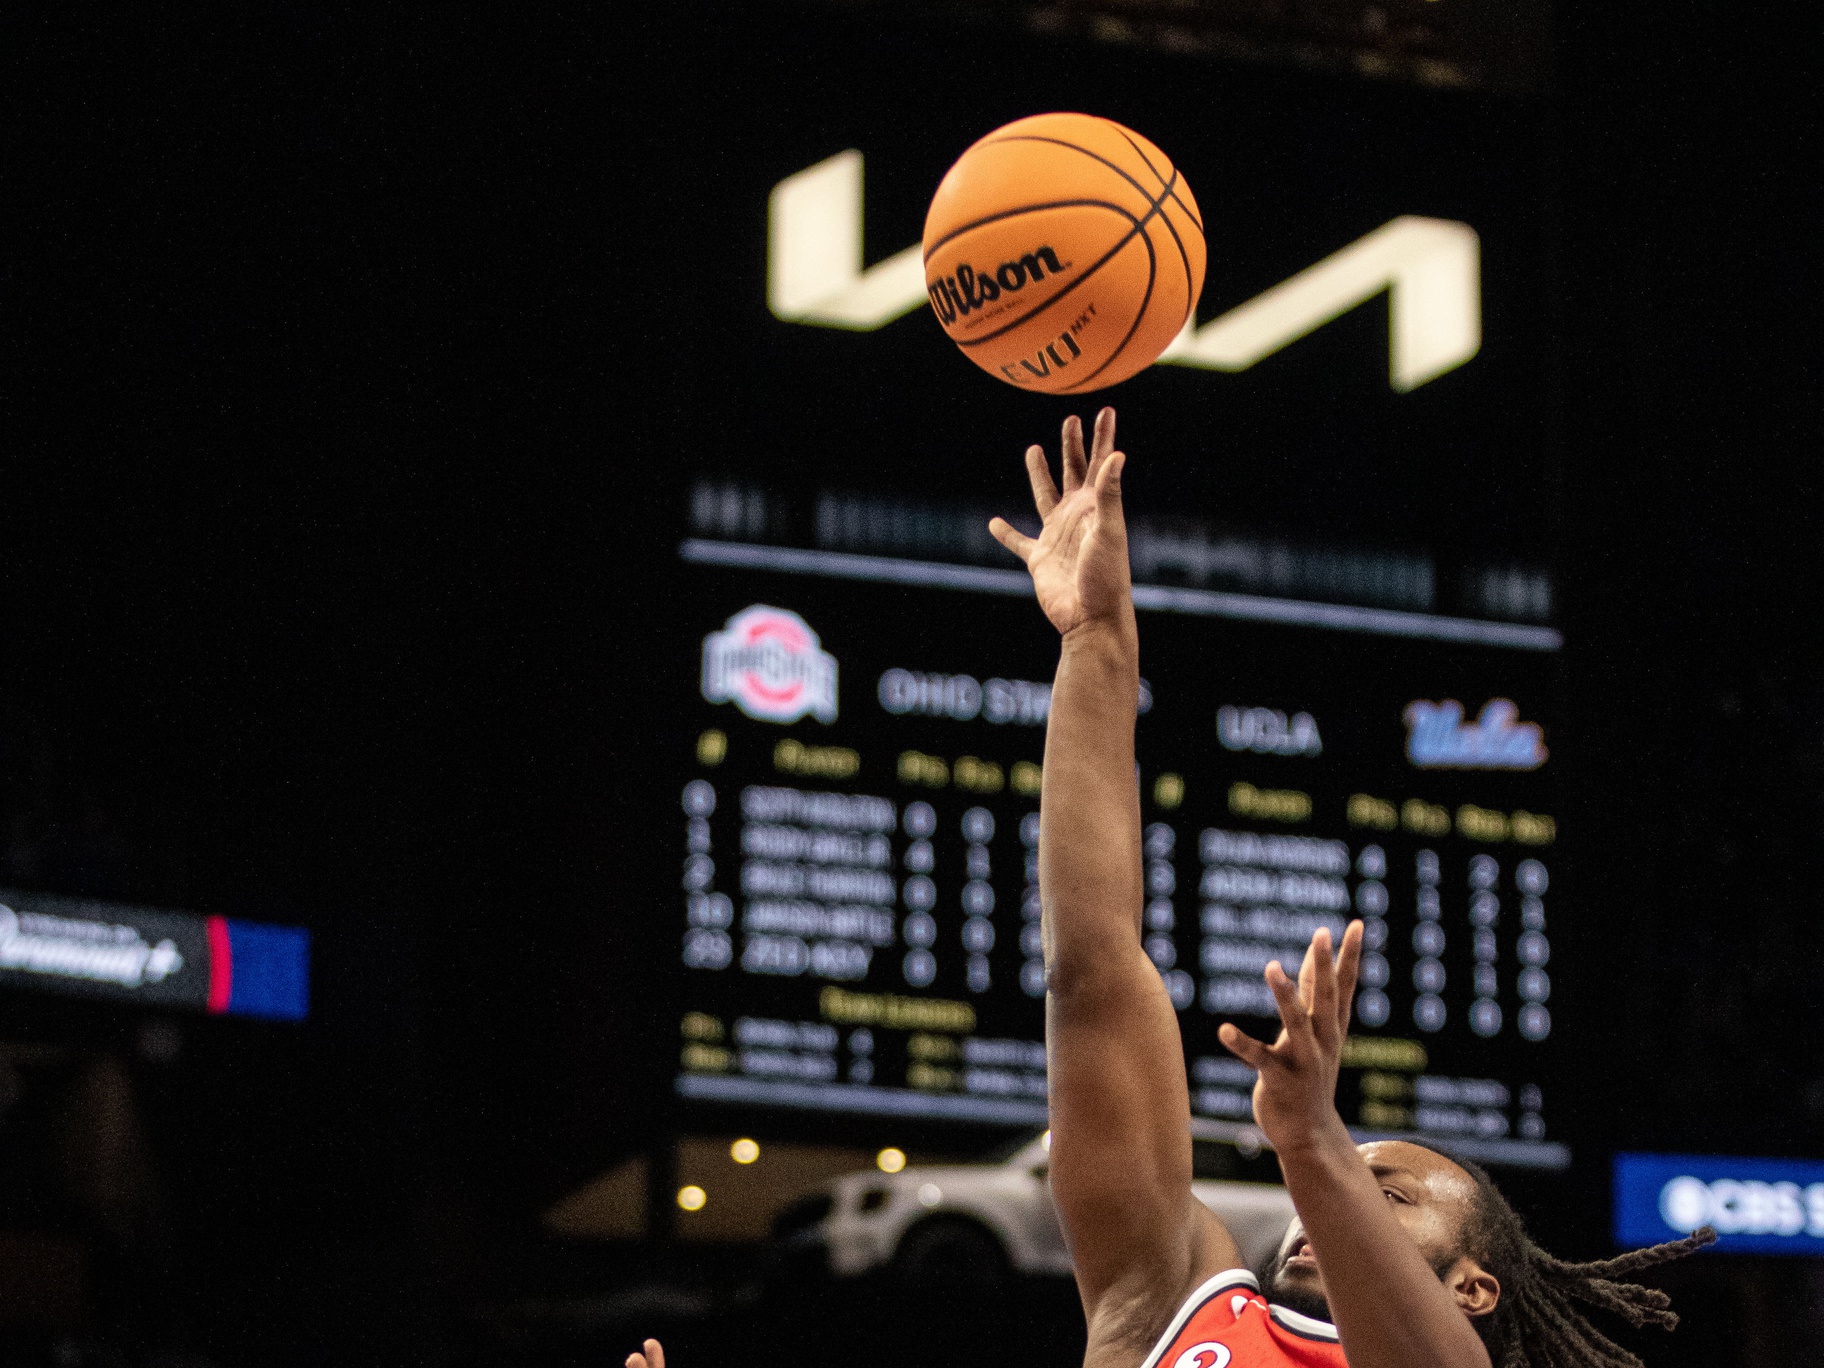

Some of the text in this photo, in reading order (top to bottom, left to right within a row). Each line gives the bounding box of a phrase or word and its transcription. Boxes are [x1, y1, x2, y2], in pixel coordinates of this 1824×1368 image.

[929, 245, 1065, 326] Wilson
[878, 668, 983, 721] OHIO
[1216, 705, 1323, 756] UCLA
[1703, 1178, 1806, 1236] CBS
